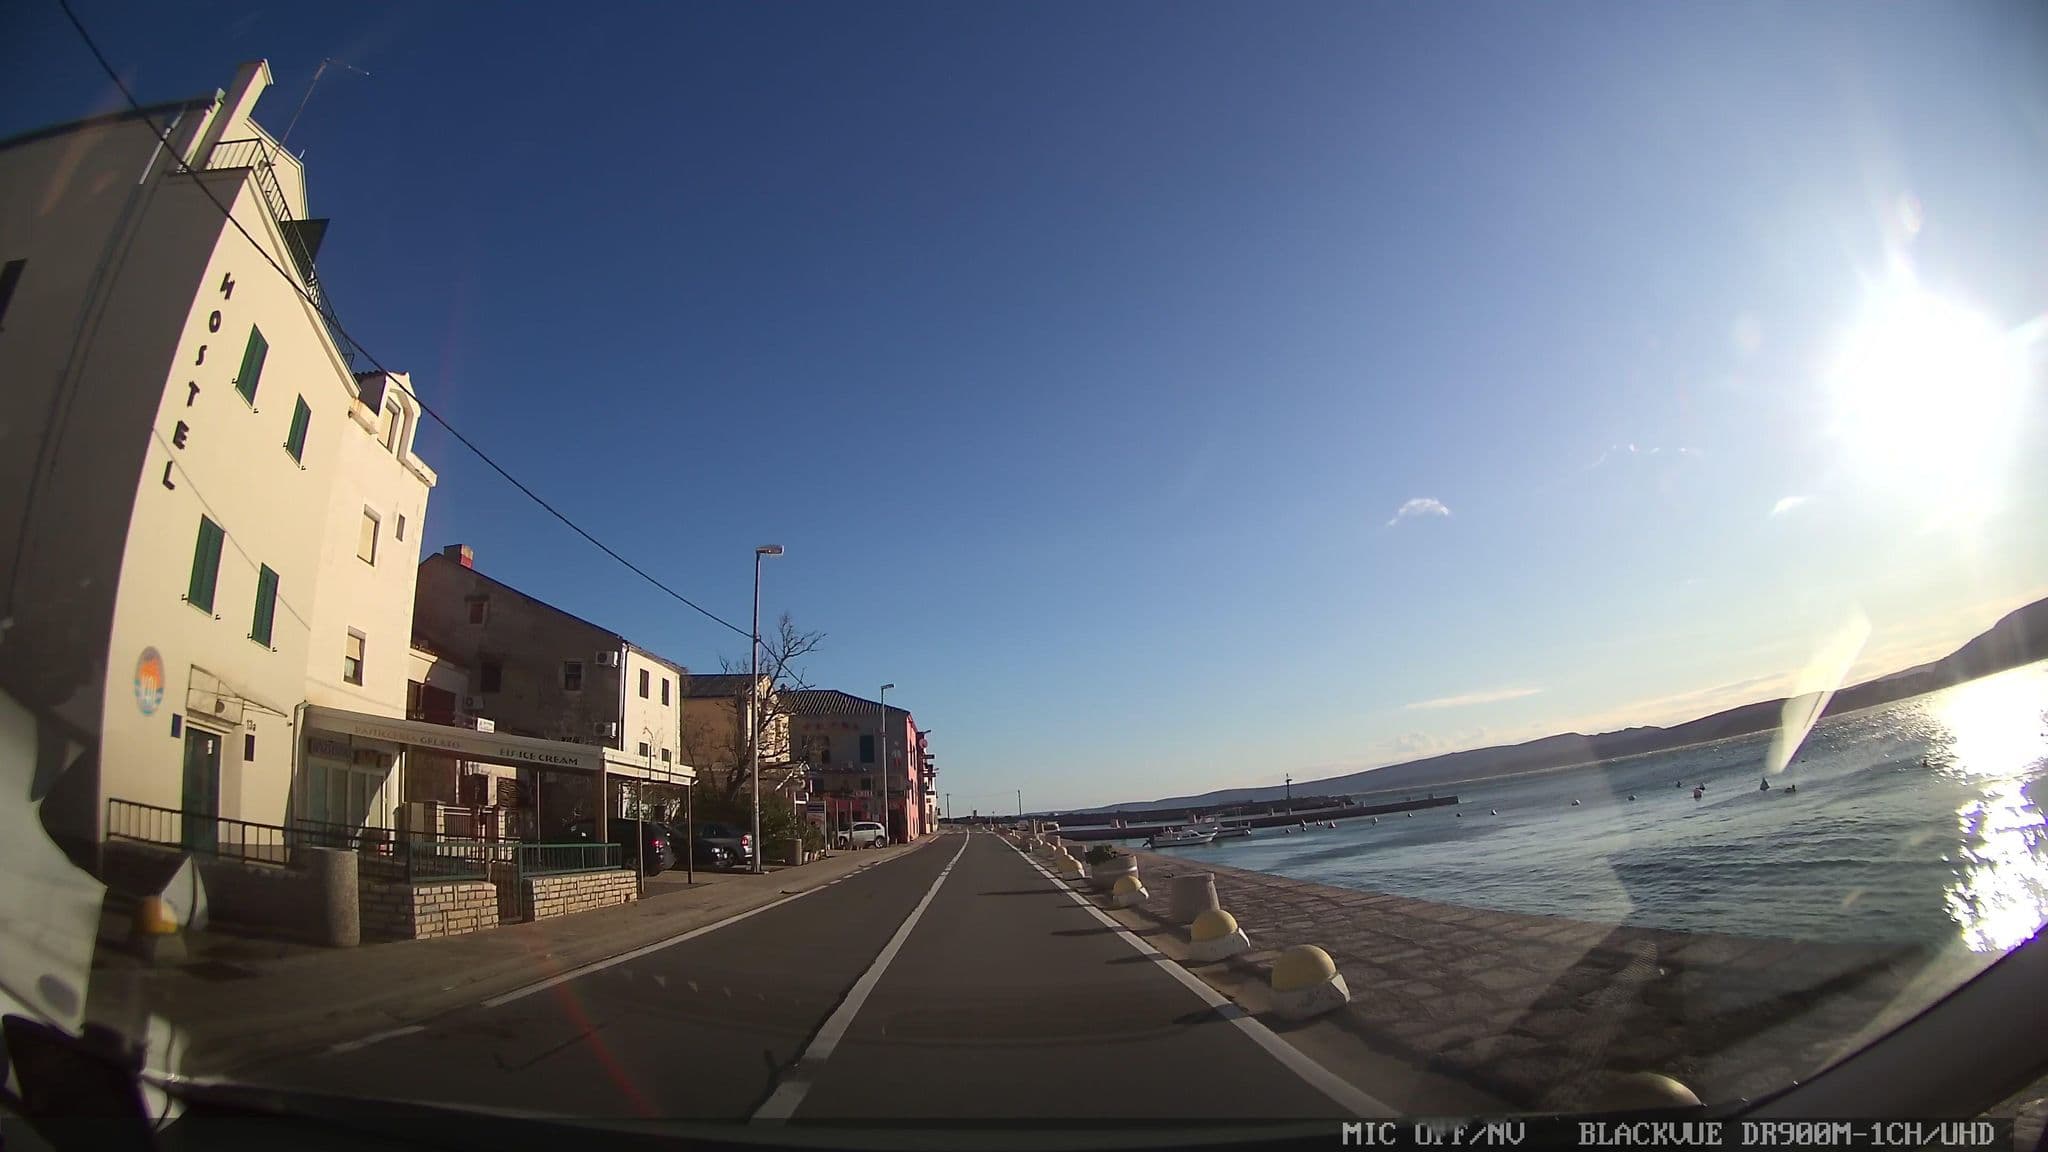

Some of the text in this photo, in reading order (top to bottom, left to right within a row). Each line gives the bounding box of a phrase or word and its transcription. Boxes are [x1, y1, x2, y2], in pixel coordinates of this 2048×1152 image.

[162, 272, 235, 490] HOSTEL
[519, 751, 536, 760] ICE
[538, 754, 578, 766] CREAM
